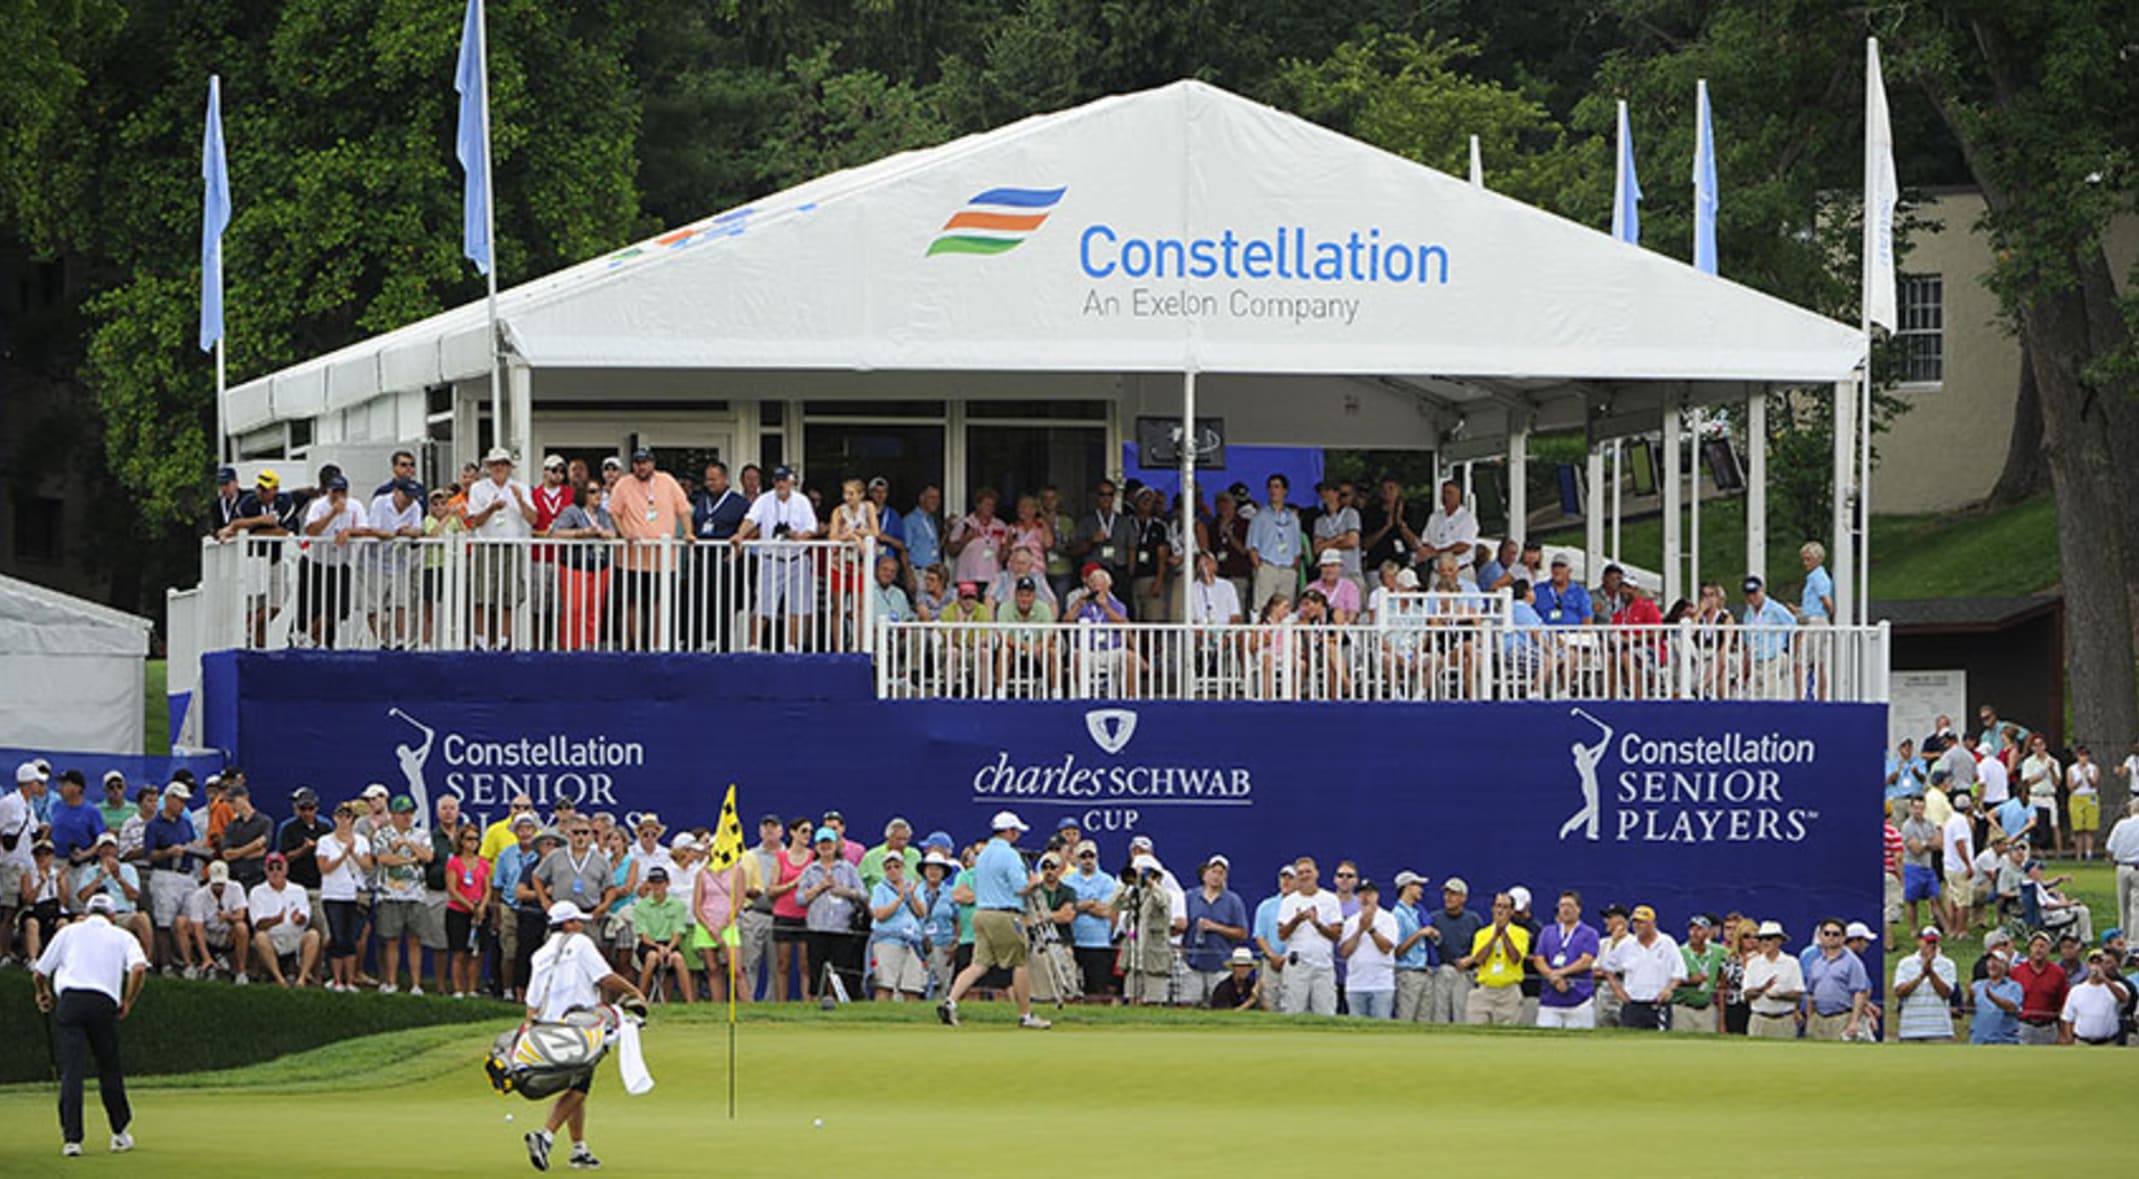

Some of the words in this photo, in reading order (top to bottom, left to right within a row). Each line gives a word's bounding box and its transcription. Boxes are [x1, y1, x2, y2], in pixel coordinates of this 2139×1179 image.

[1080, 225, 1449, 285] Constellation
[1083, 290, 1119, 317] An
[1133, 289, 1219, 318] Exelon
[1230, 290, 1360, 325] Company
[443, 734, 643, 766] Constellation
[1620, 733, 1815, 764] Constellation
[446, 773, 618, 805] SENIOR
[973, 752, 1104, 796] charles
[1109, 767, 1251, 796] SCHWAB
[1617, 769, 1783, 803] SENIOR
[1083, 809, 1139, 831] CUP
